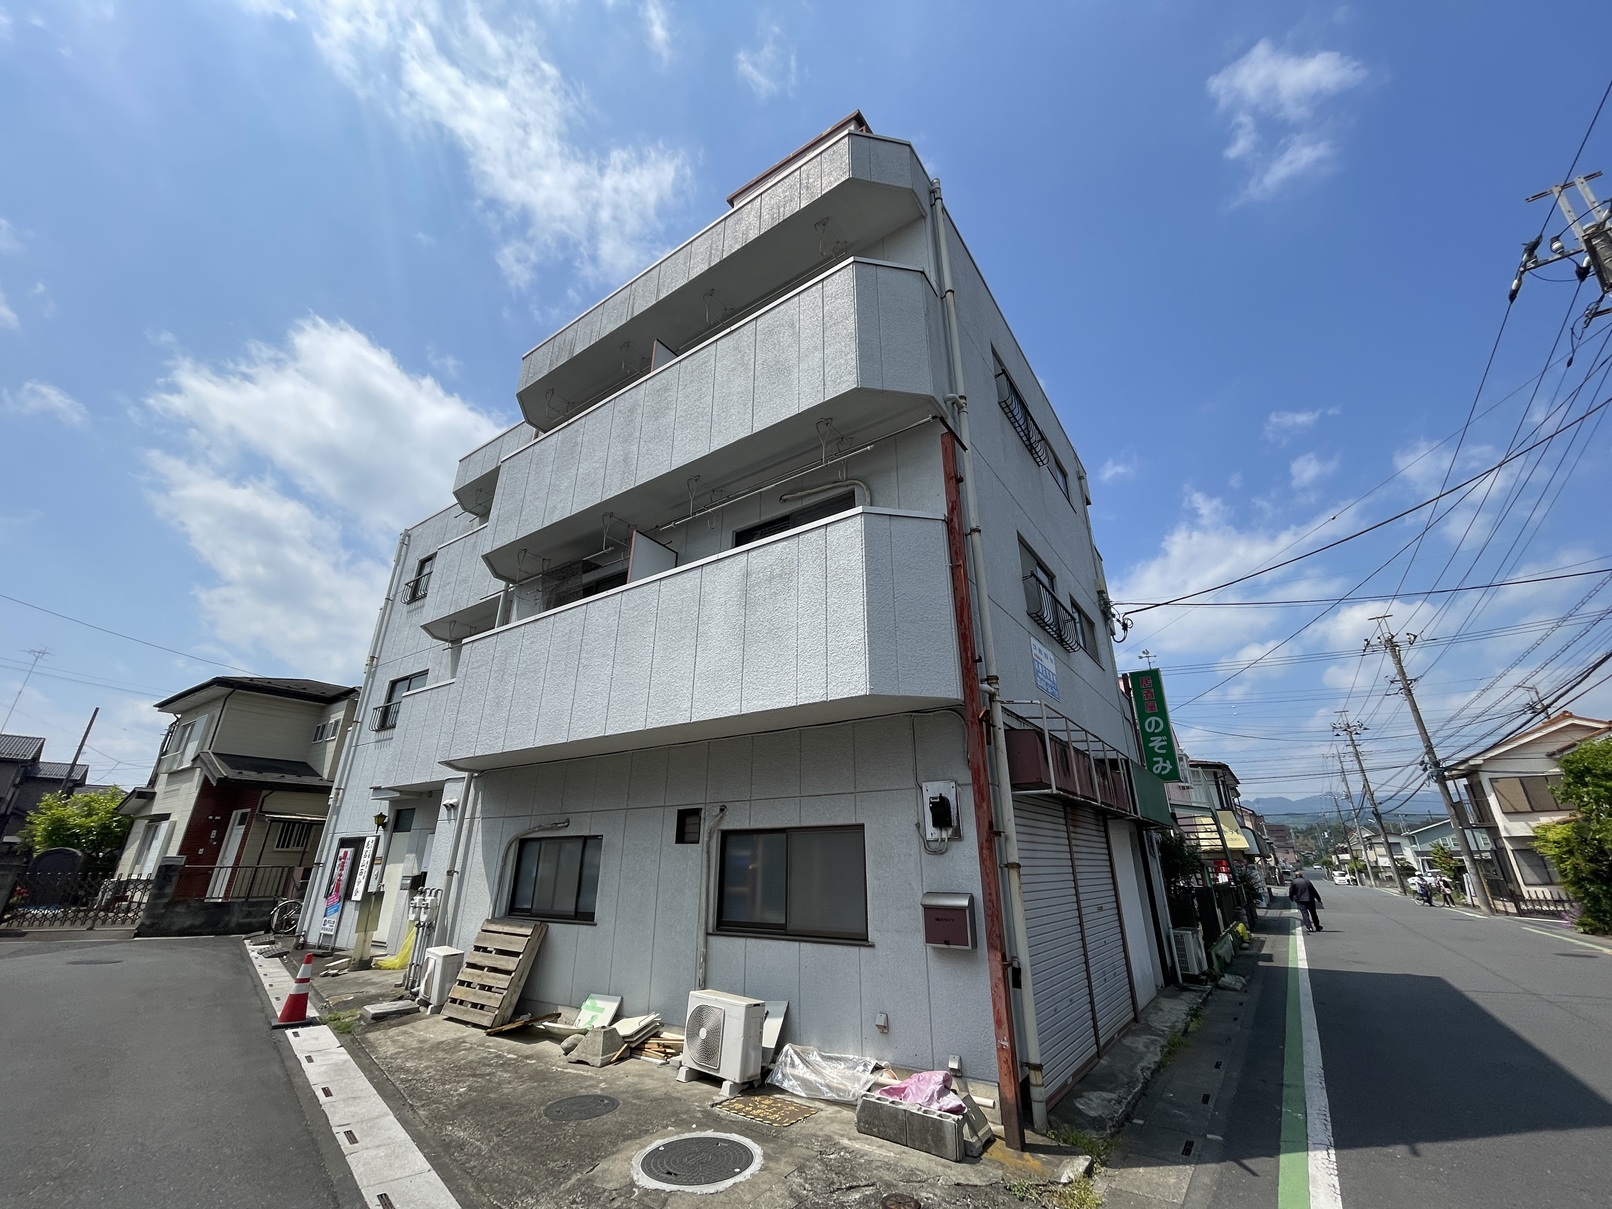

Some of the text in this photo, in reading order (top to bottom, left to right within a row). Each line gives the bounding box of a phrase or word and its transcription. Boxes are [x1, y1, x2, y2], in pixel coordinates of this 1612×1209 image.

[1140, 676, 1173, 775] 居酒屋 のぞみ
